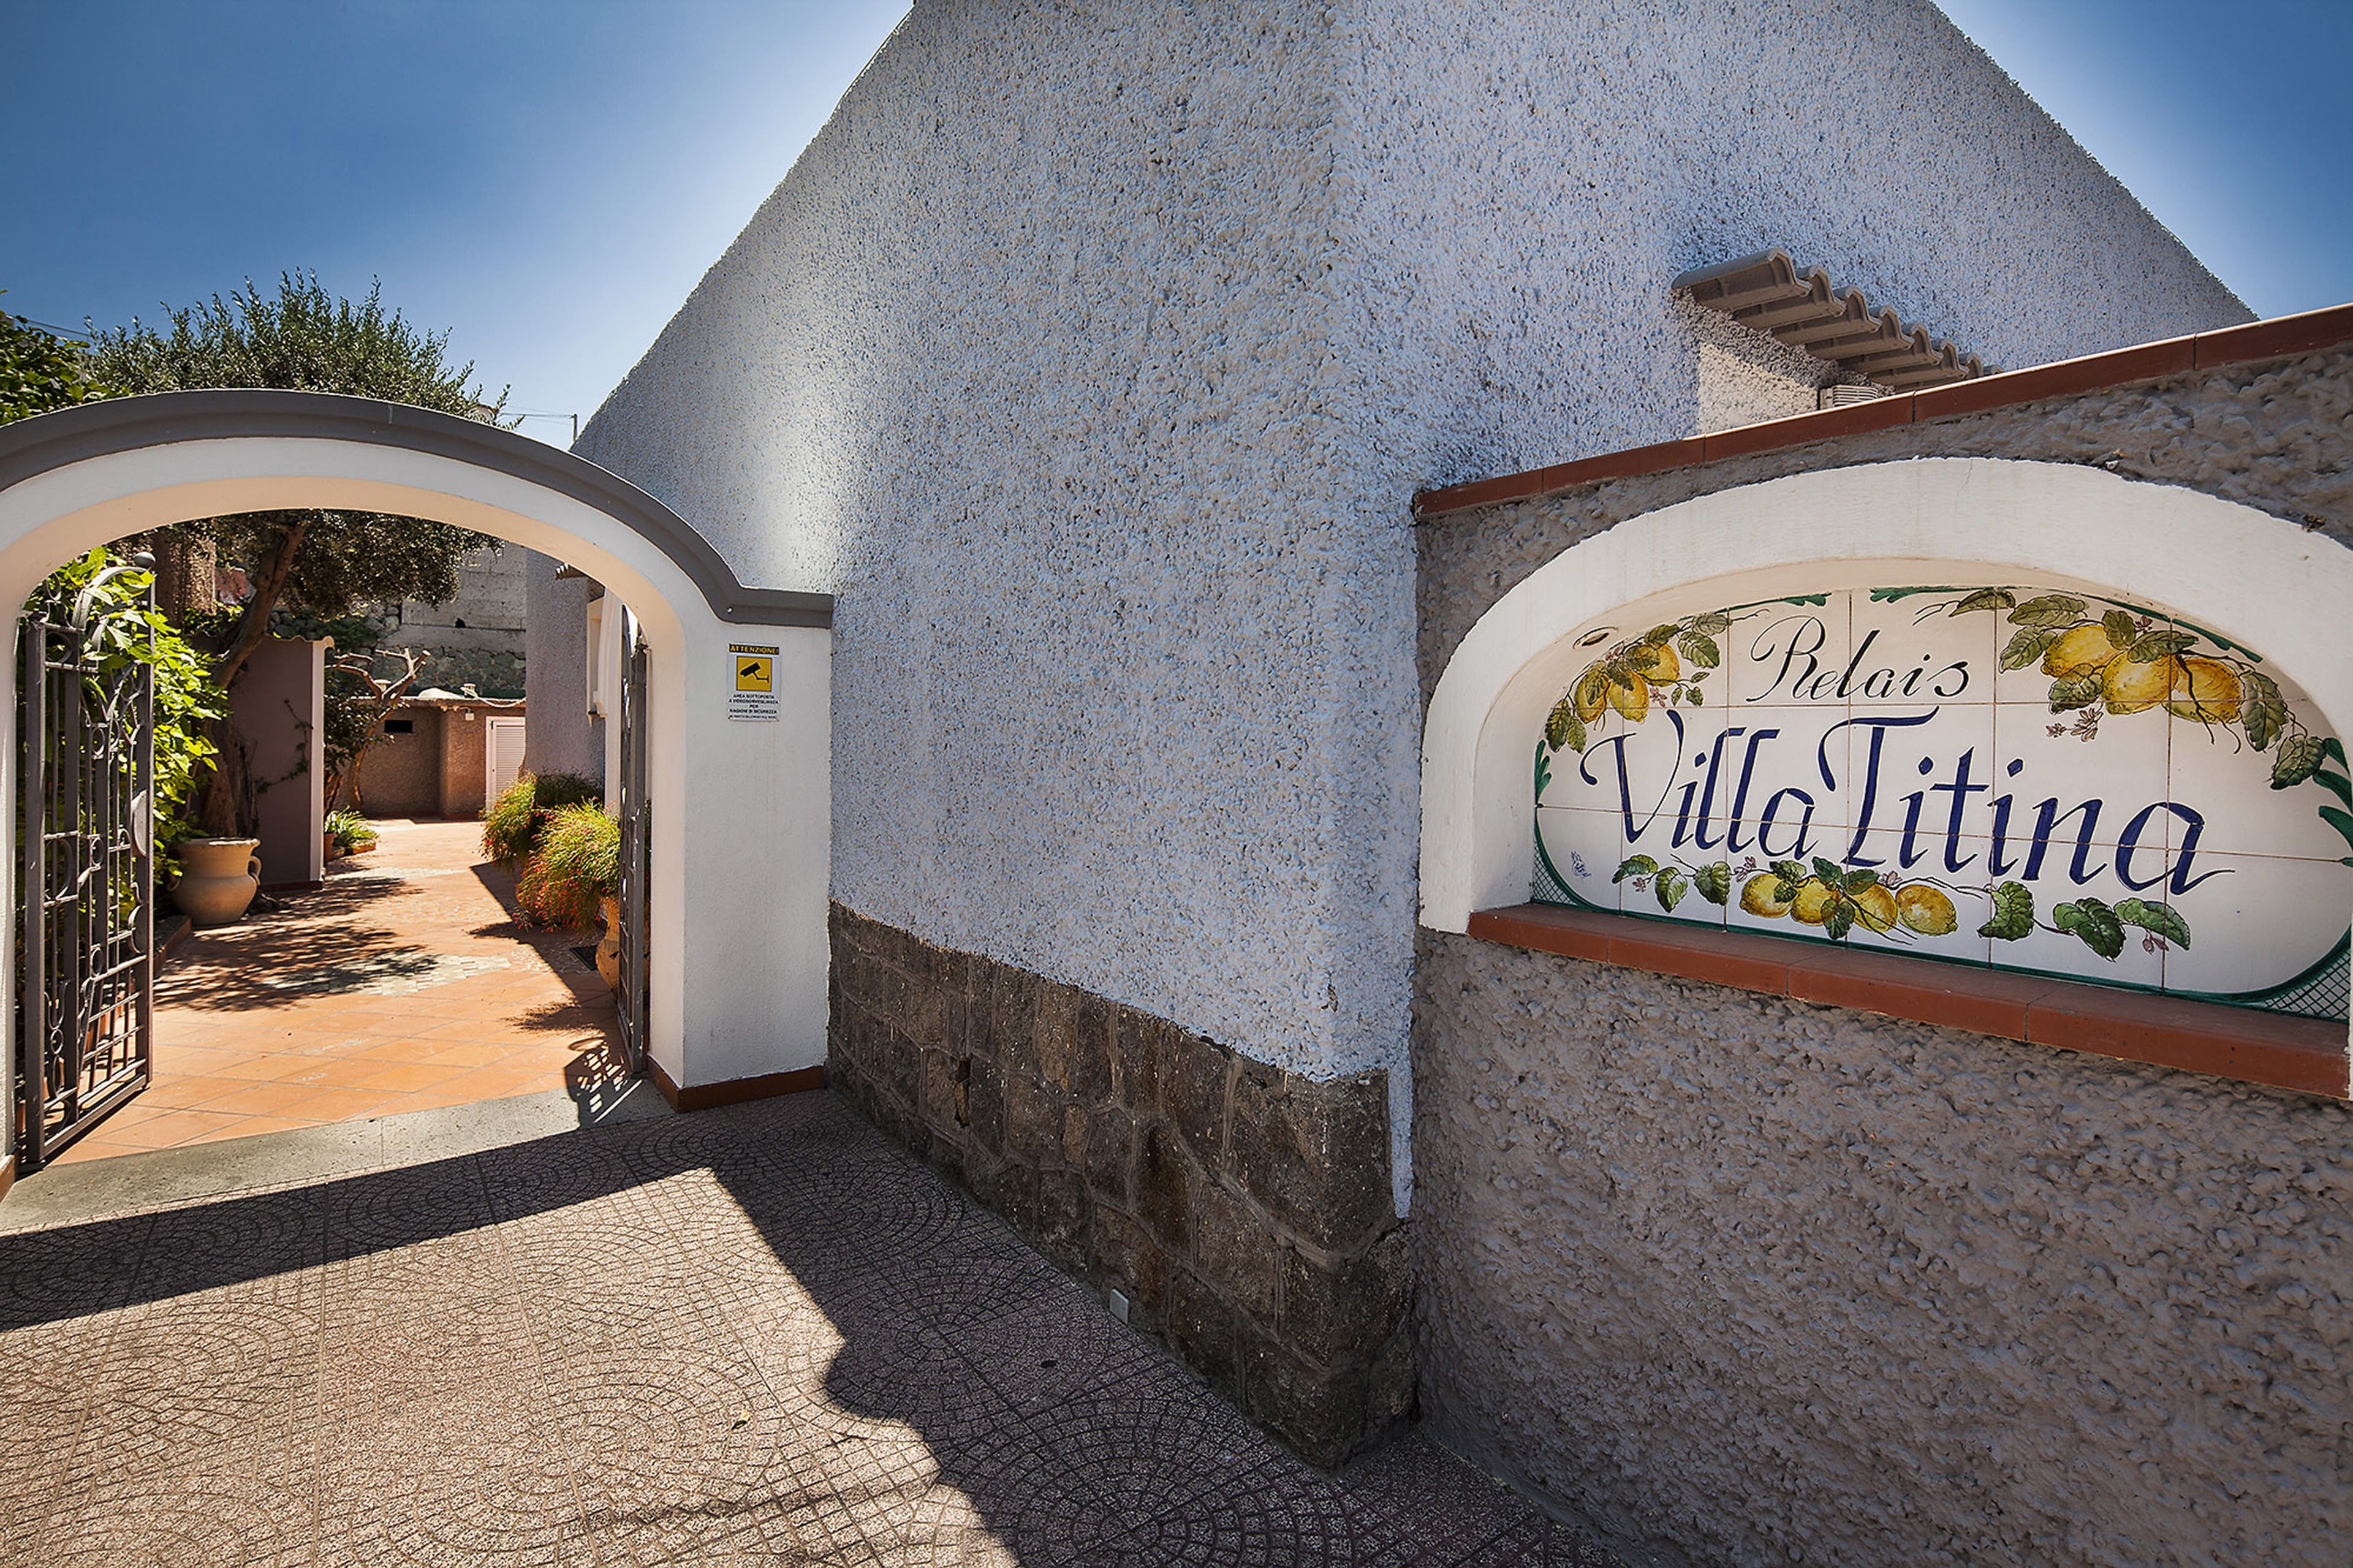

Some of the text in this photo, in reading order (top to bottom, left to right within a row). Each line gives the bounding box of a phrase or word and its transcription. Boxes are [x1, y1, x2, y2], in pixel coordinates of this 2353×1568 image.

[1745, 615, 1971, 702] Relais
[1579, 705, 2237, 896] Villa Titina
